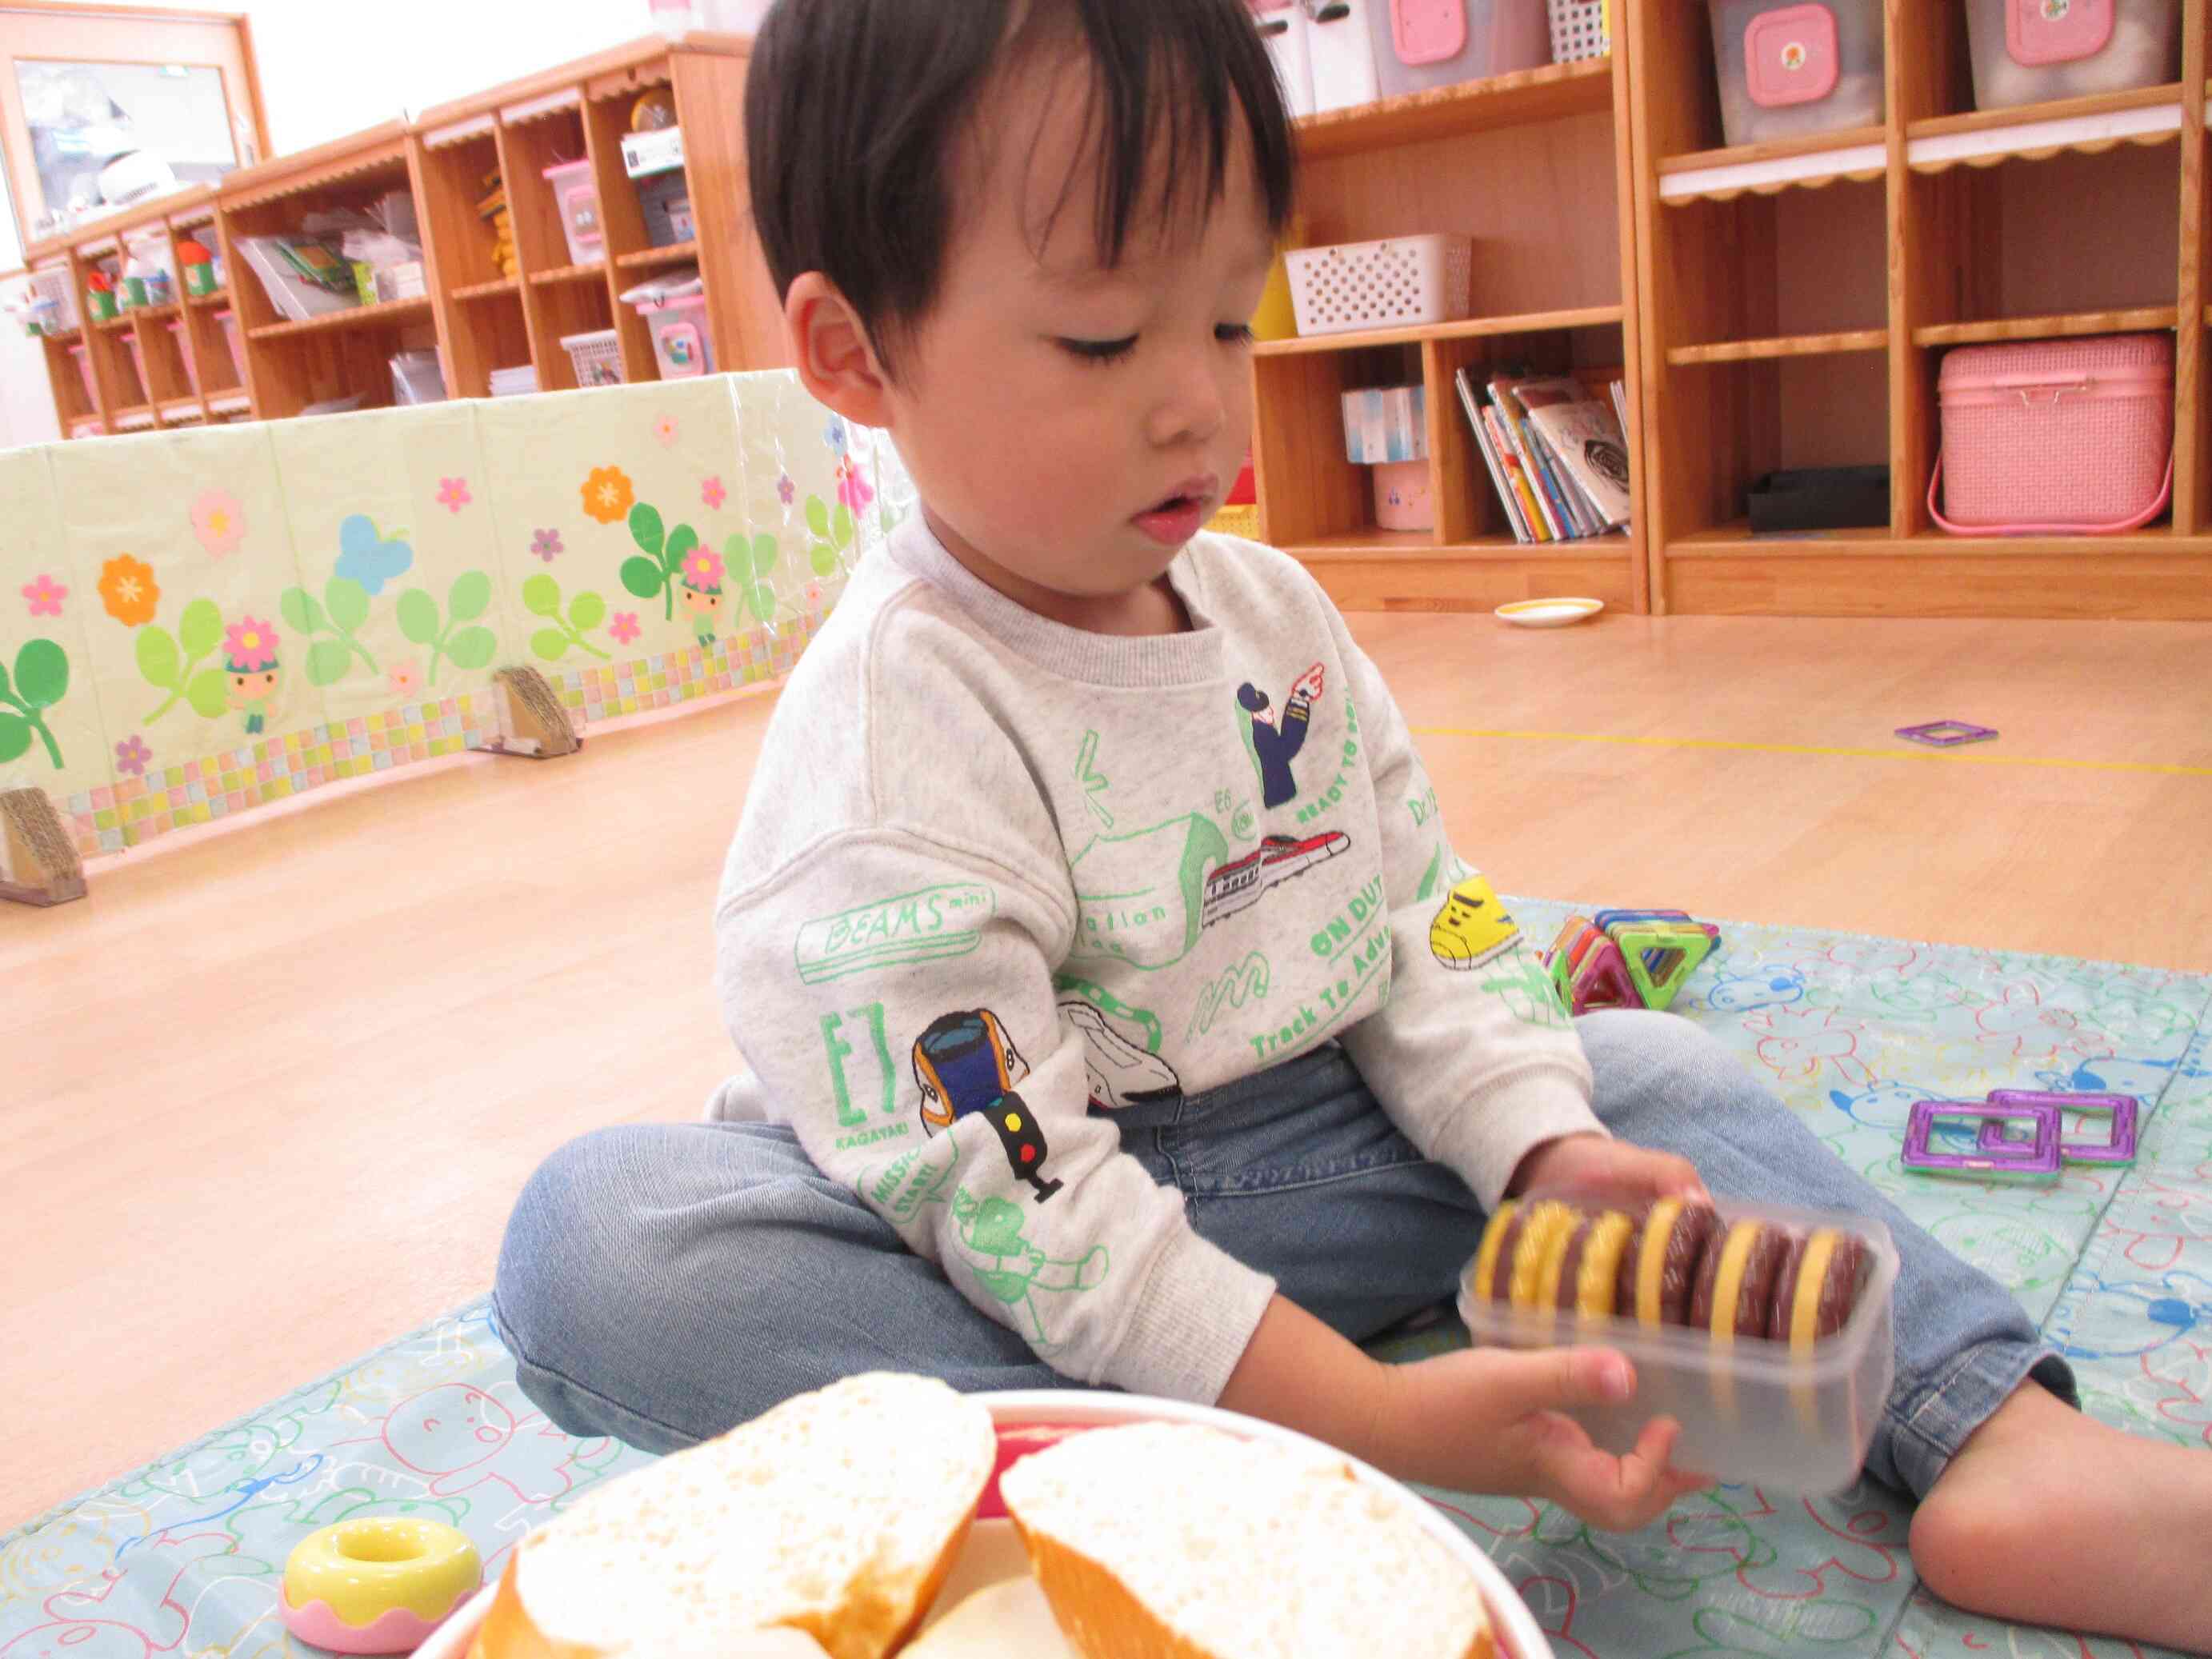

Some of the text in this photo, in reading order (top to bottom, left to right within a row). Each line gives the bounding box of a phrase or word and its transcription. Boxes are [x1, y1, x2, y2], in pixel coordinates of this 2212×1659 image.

[1296, 771, 1348, 823] READY
[824, 893, 944, 953] BEAMS
[1310, 913, 1352, 956] ON
[1250, 1004, 1317, 1058] Track
[820, 1000, 895, 1127] E7
